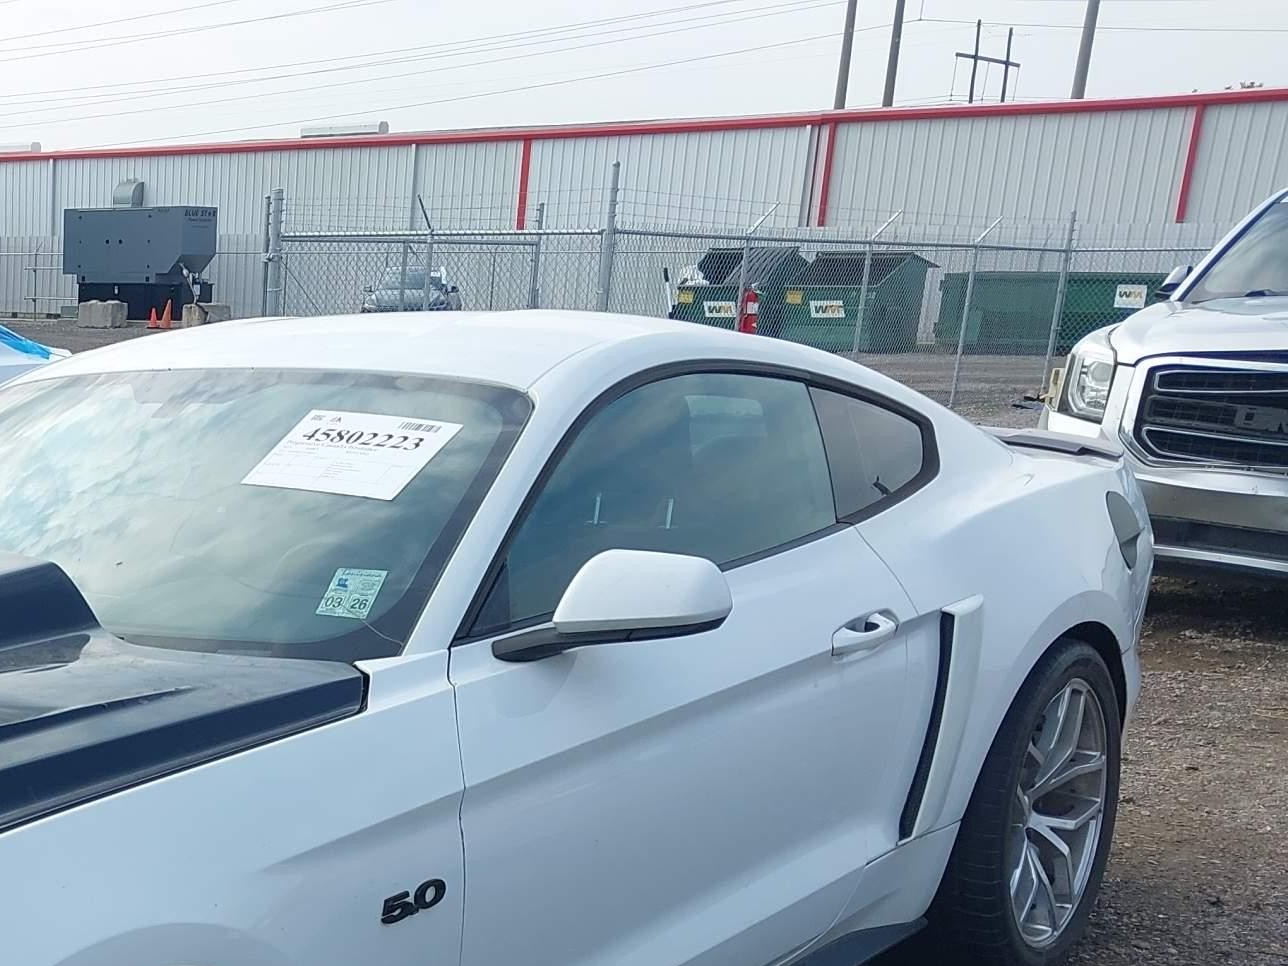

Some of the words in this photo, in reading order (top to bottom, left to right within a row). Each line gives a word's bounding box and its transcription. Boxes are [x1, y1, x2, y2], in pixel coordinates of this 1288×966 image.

[302, 427, 425, 451] 45802223
[324, 596, 343, 608] 03
[350, 598, 369, 610] 26
[380, 878, 447, 925] 5.0
